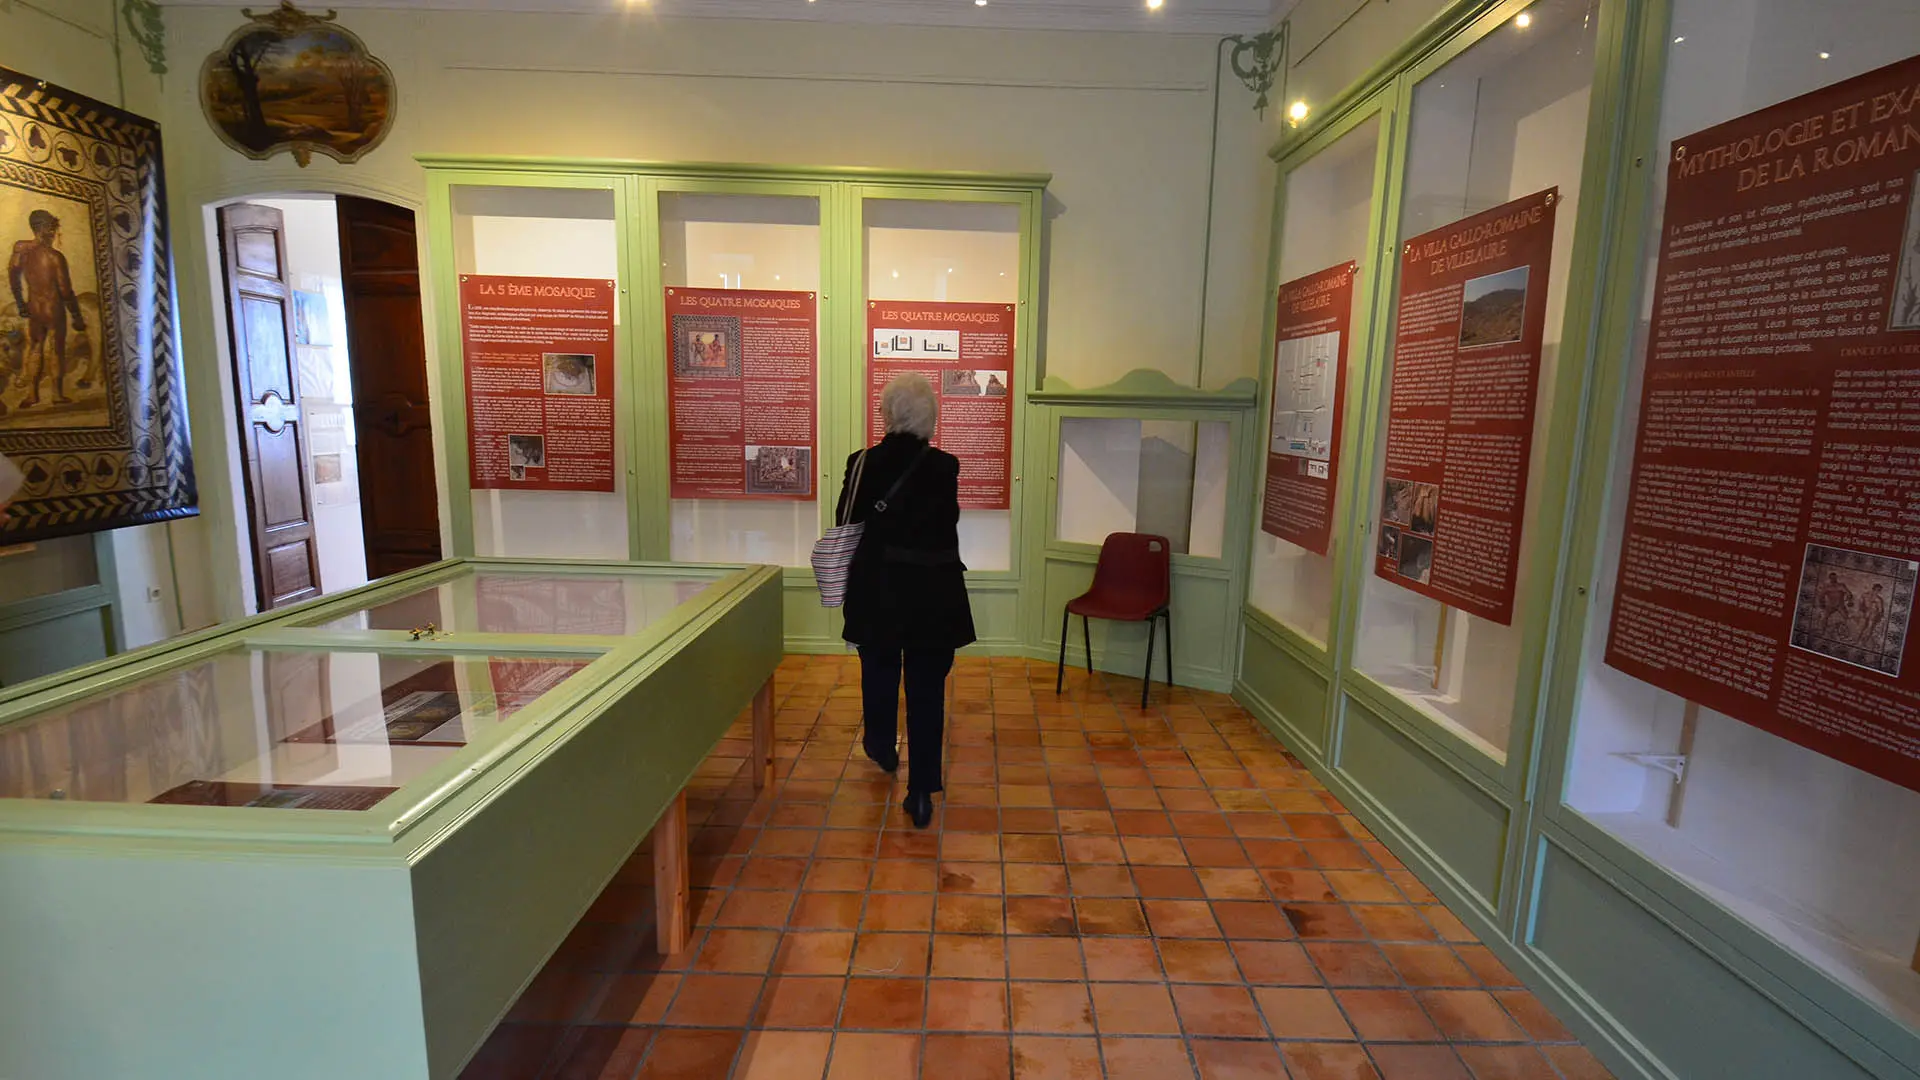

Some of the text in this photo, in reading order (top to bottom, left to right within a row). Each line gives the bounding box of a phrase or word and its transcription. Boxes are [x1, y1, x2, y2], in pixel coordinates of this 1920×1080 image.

[1677, 114, 1825, 178] MYTHOLOGIE
[1830, 102, 1864, 135] ET
[1736, 162, 1771, 191] DE
[1773, 152, 1808, 182] LA
[1859, 181, 1879, 195] sont
[1410, 248, 1421, 263] LA
[1424, 239, 1447, 257] VILLA
[1430, 239, 1508, 275] DE VILLELAURE
[480, 284, 495, 295] LA
[498, 285, 505, 295] 5
[508, 283, 532, 296] ÈME
[680, 296, 697, 306] LES
[699, 296, 740, 308] QUATRE
[881, 311, 898, 320] LES
[901, 312, 941, 322] QUATRE
